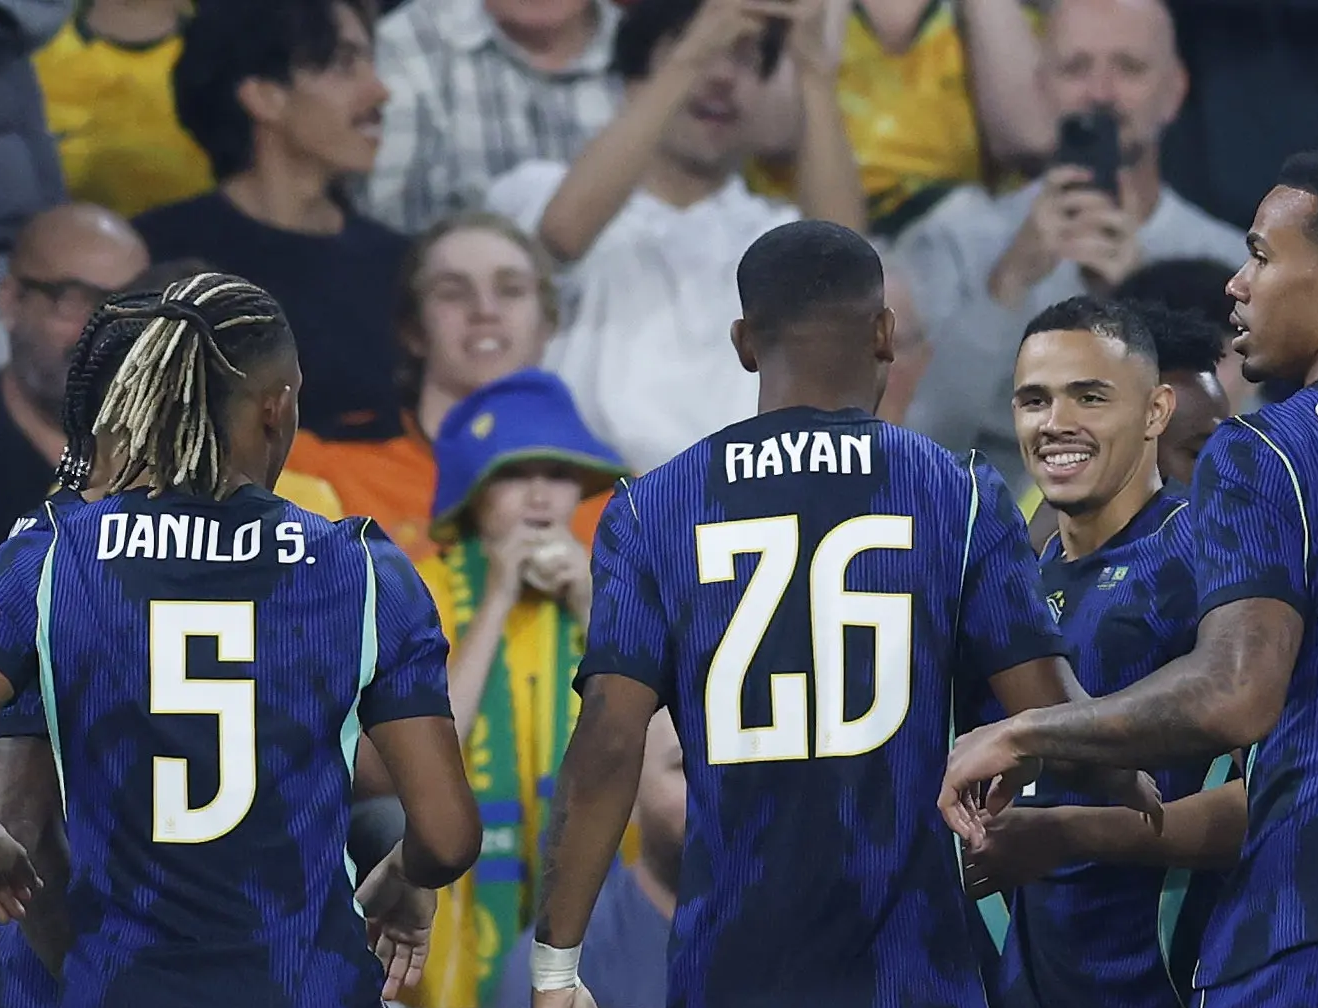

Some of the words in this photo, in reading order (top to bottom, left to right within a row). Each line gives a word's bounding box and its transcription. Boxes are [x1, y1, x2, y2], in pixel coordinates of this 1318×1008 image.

[725, 431, 872, 483] RAYAN
[97, 512, 262, 562] DANILO
[275, 521, 316, 564] S.
[695, 514, 913, 765] 26
[150, 600, 256, 843] 5
